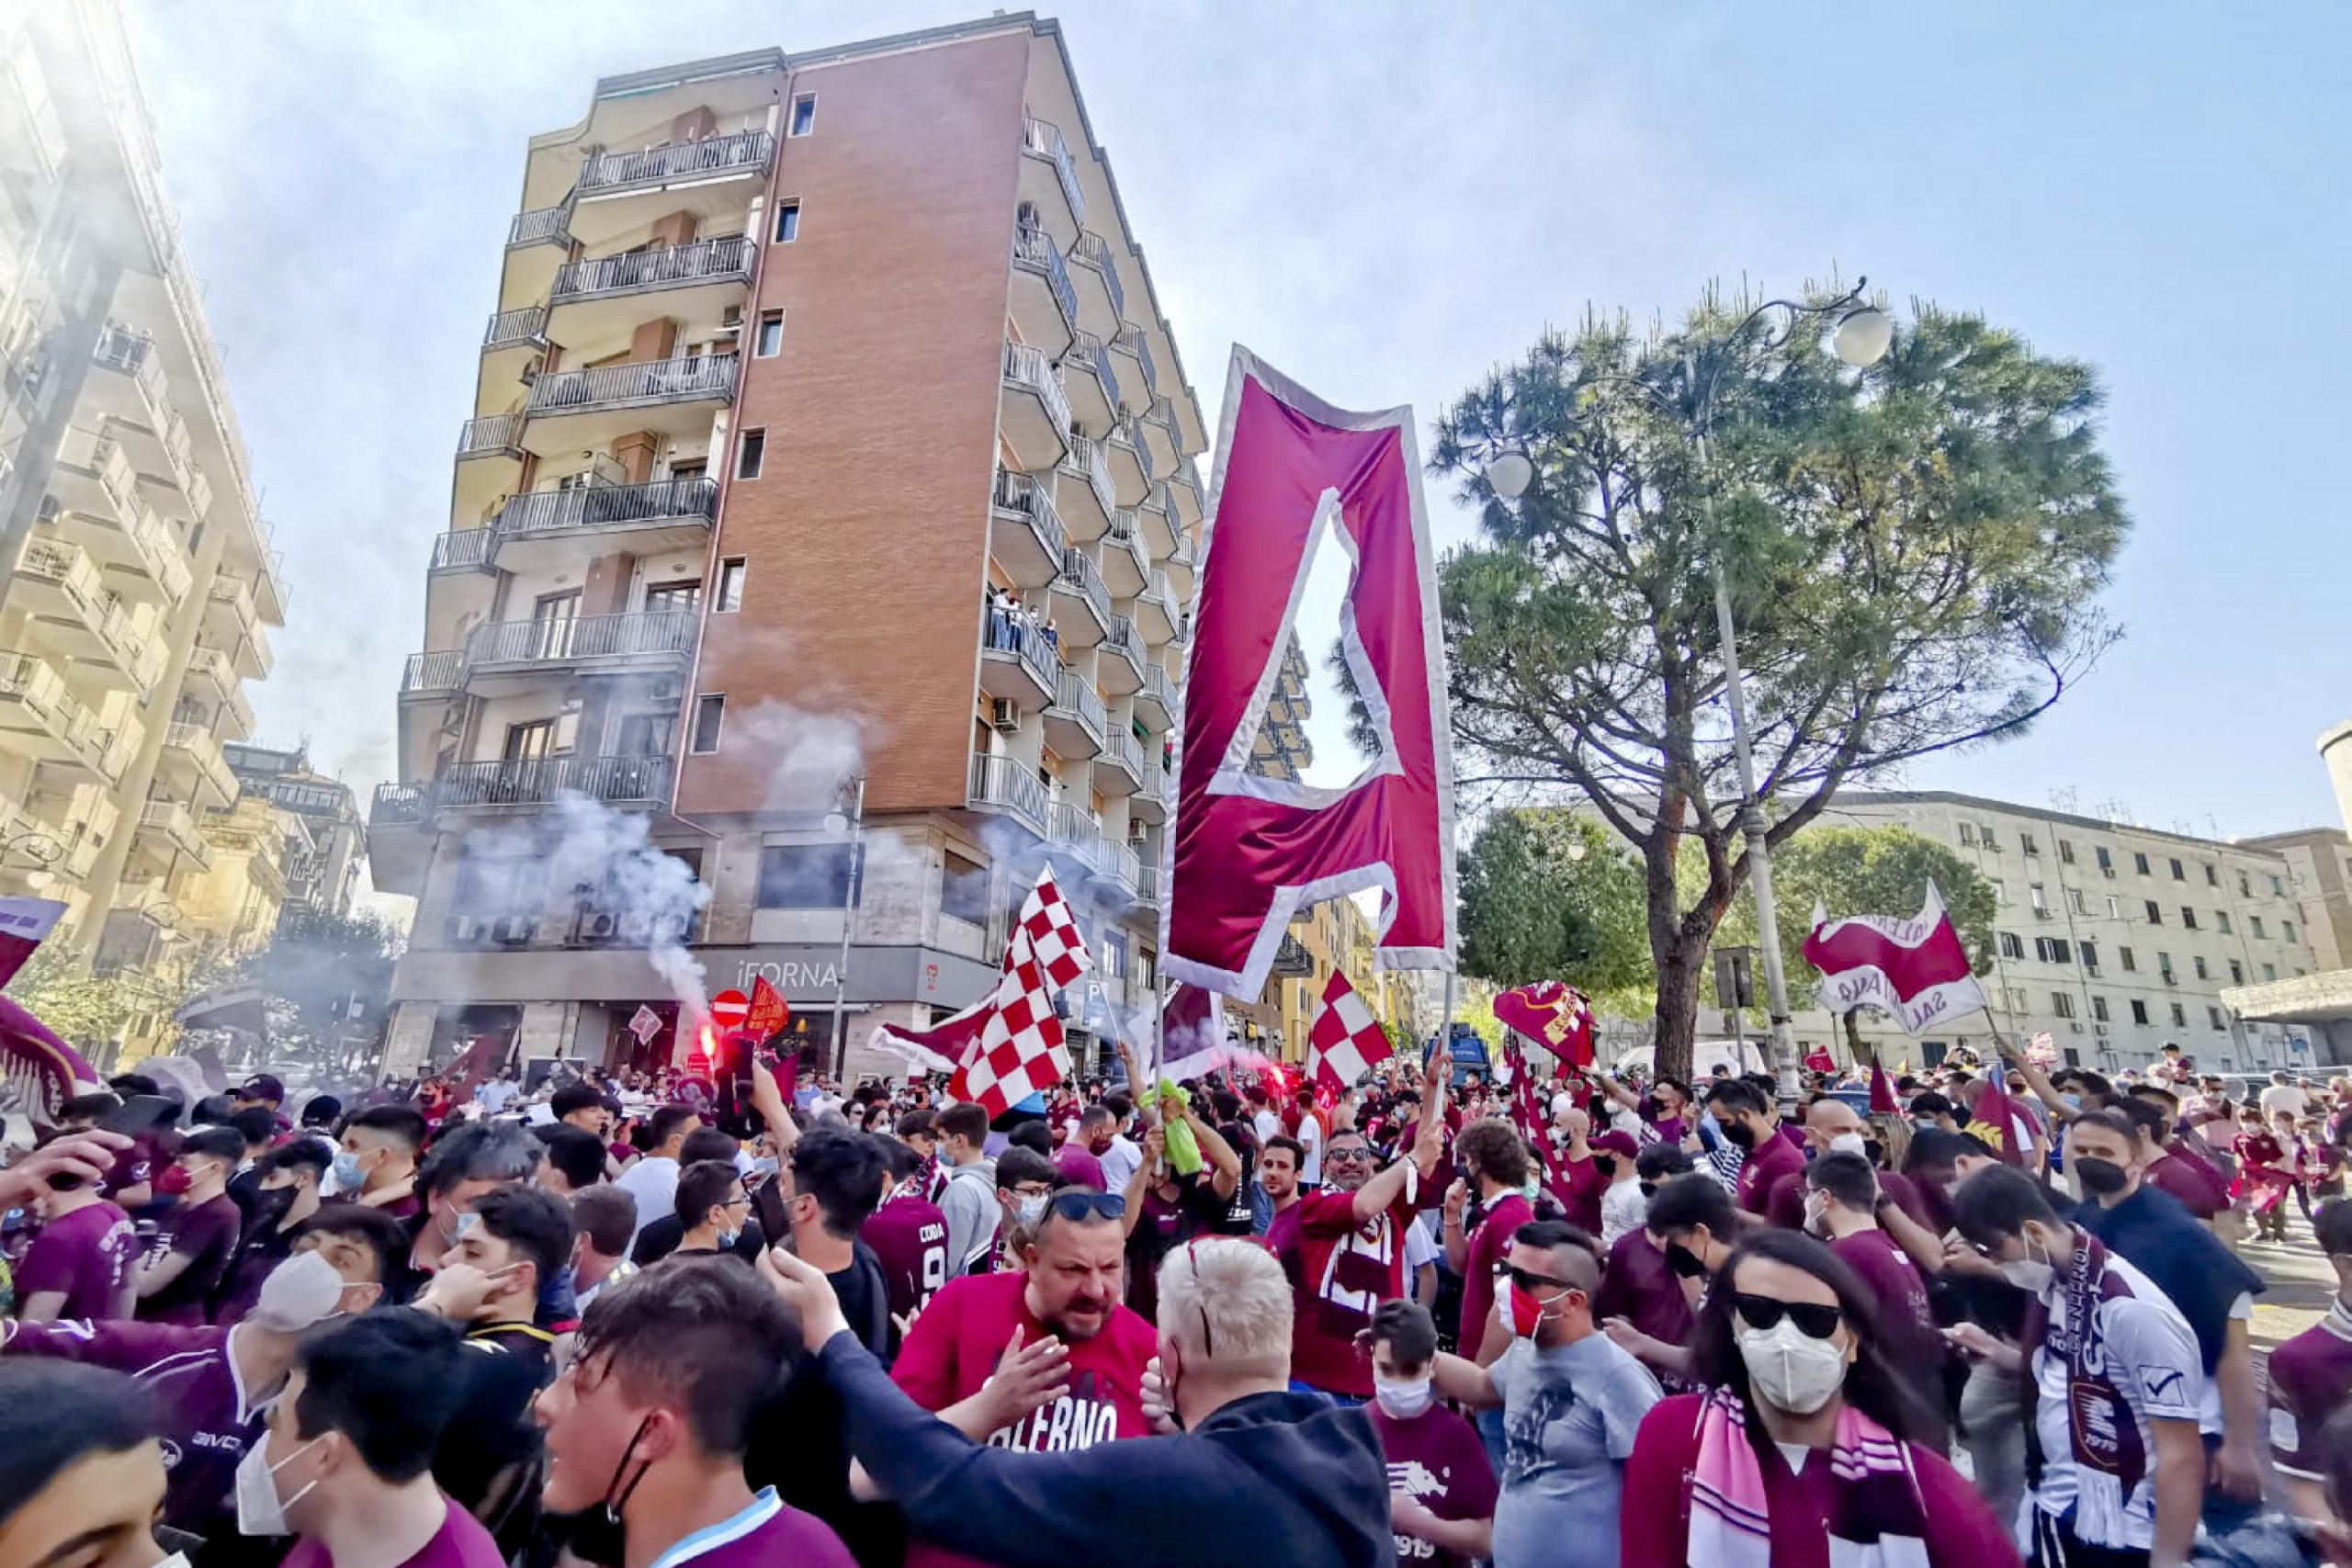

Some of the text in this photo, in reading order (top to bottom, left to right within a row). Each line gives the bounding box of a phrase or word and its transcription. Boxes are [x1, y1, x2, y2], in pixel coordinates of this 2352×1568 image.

[1089, 984, 1101, 1001] P
[920, 1223, 944, 1243] CODA
[921, 1246, 945, 1312] 9
